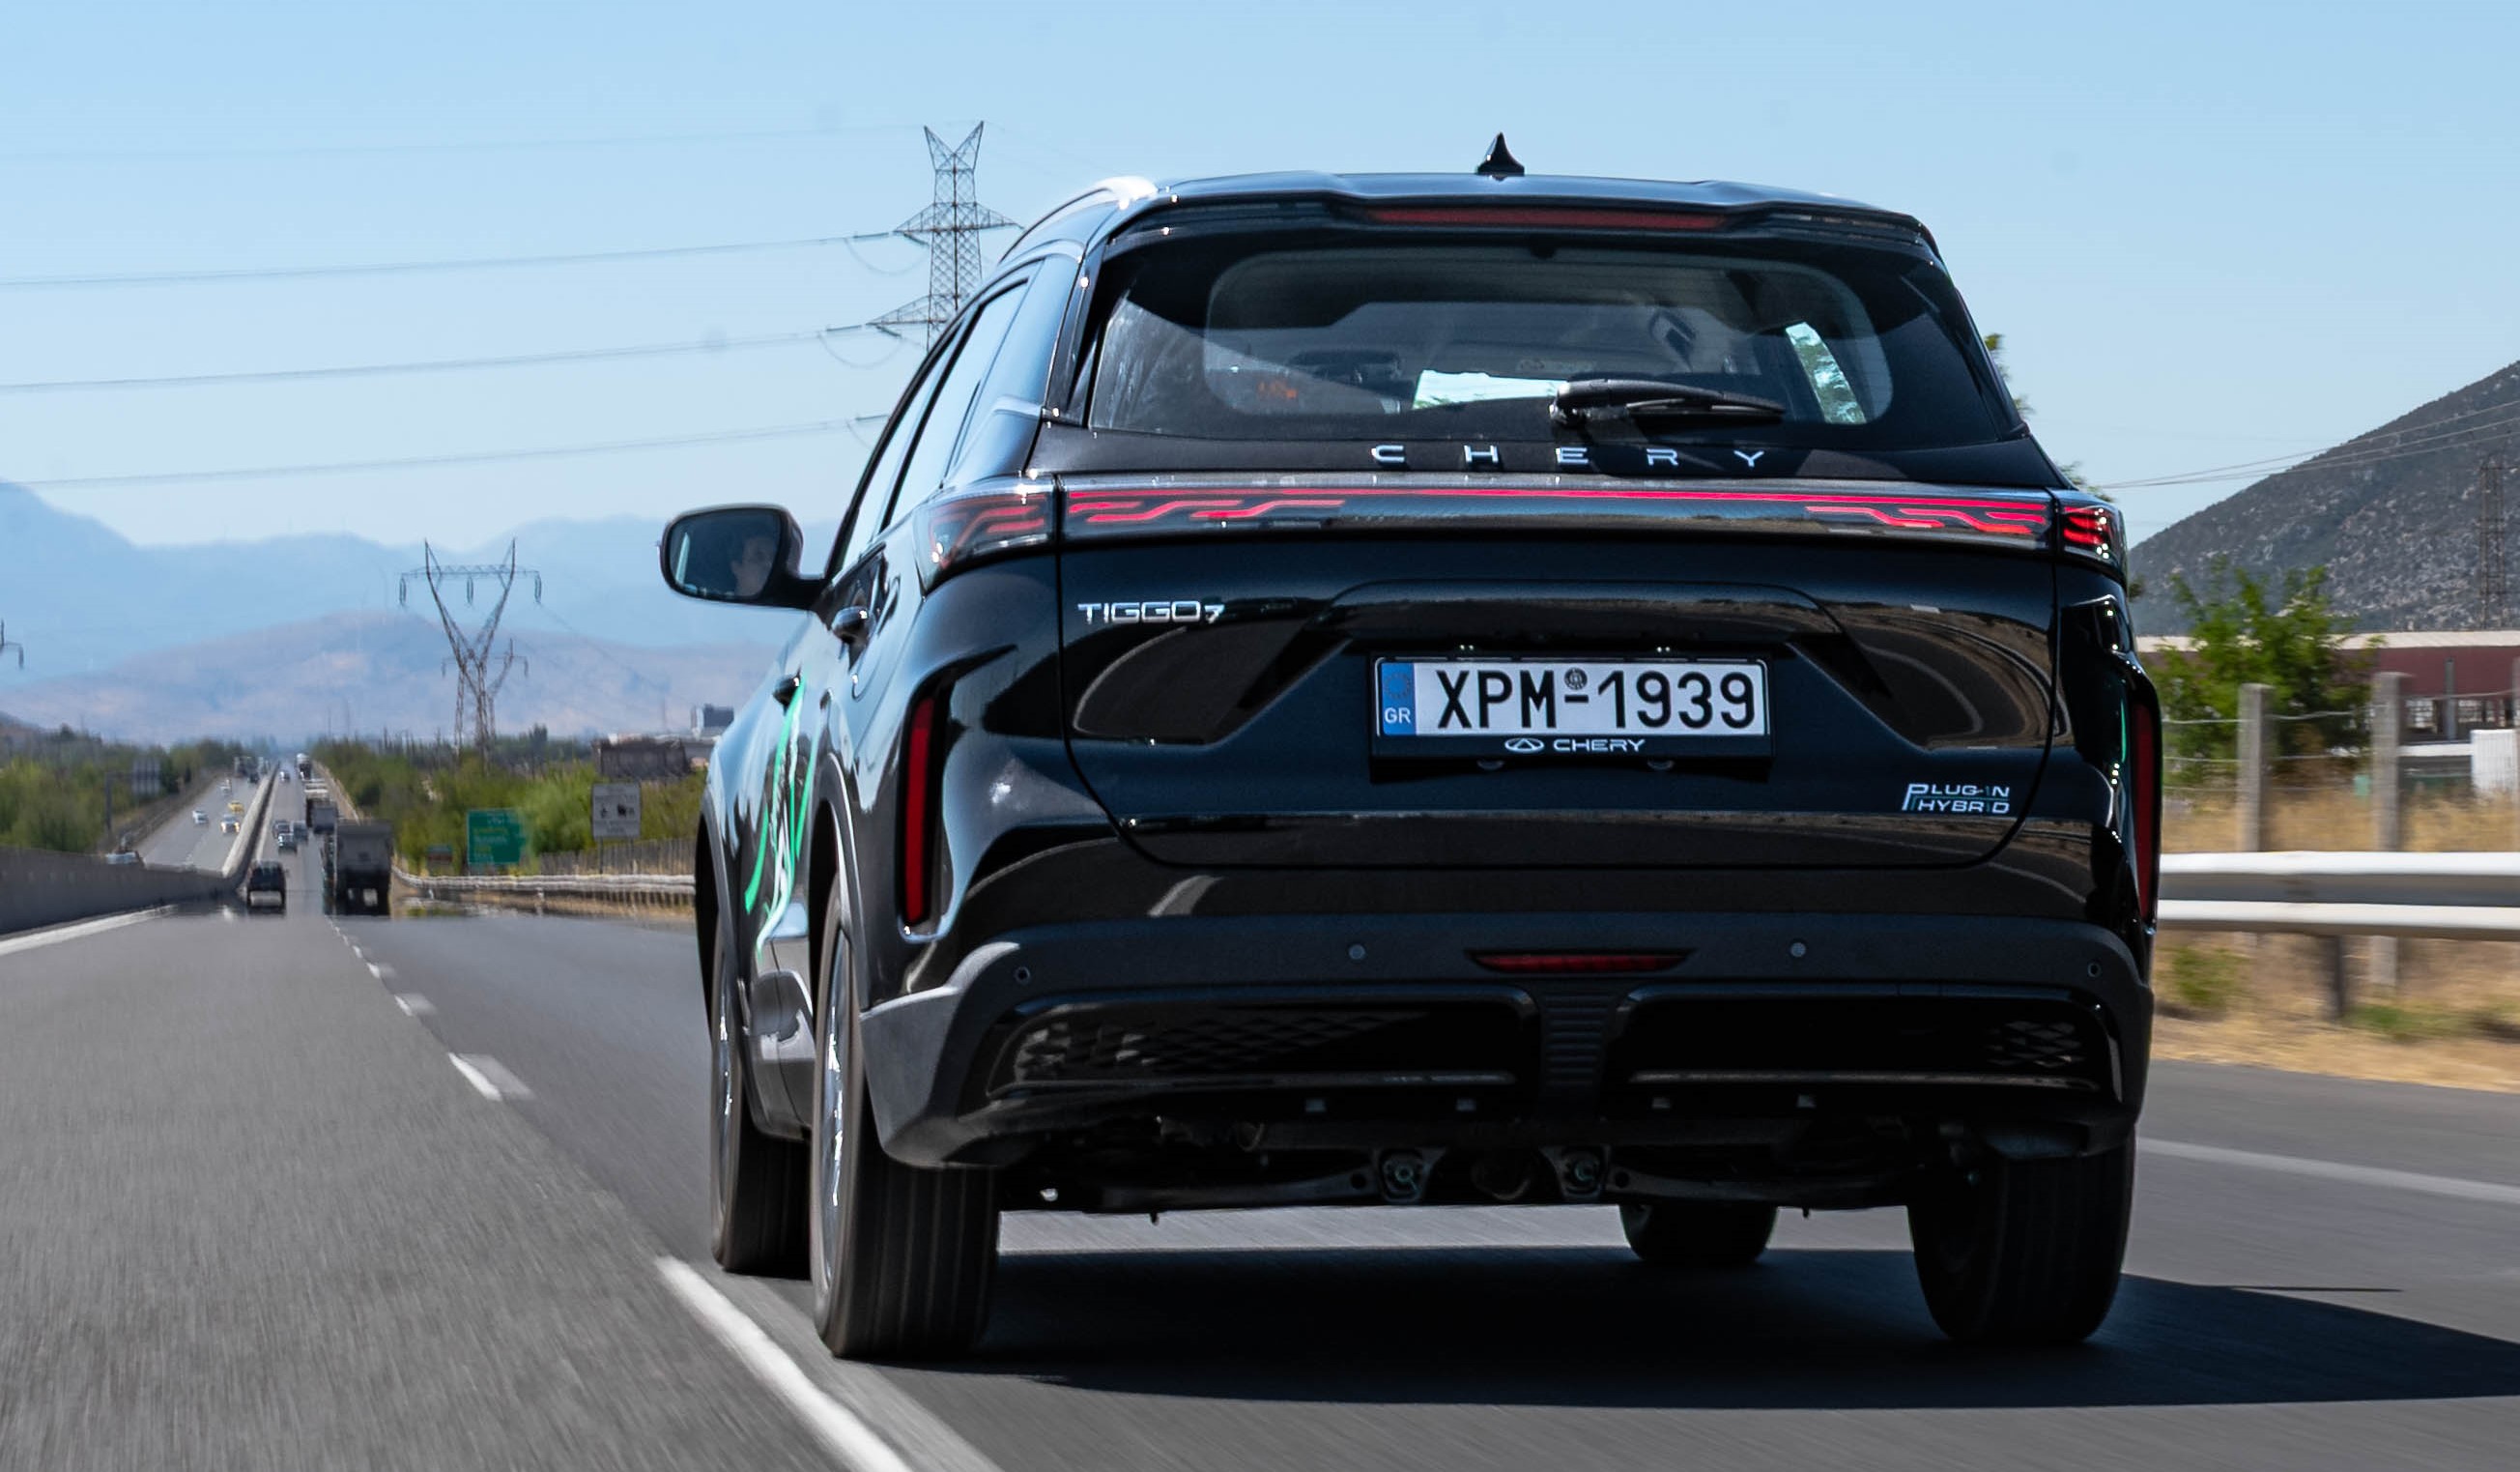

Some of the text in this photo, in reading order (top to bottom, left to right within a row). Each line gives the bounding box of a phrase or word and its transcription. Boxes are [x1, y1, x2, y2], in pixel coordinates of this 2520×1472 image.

[1372, 445, 1765, 467] CHERY
[1436, 670, 1756, 729] XPM-1939
[1385, 707, 1411, 724] GR
[1553, 737, 1646, 753] CHERY
[1902, 783, 2010, 811] PLUG-IN
[1917, 800, 2010, 814] HYBRID
